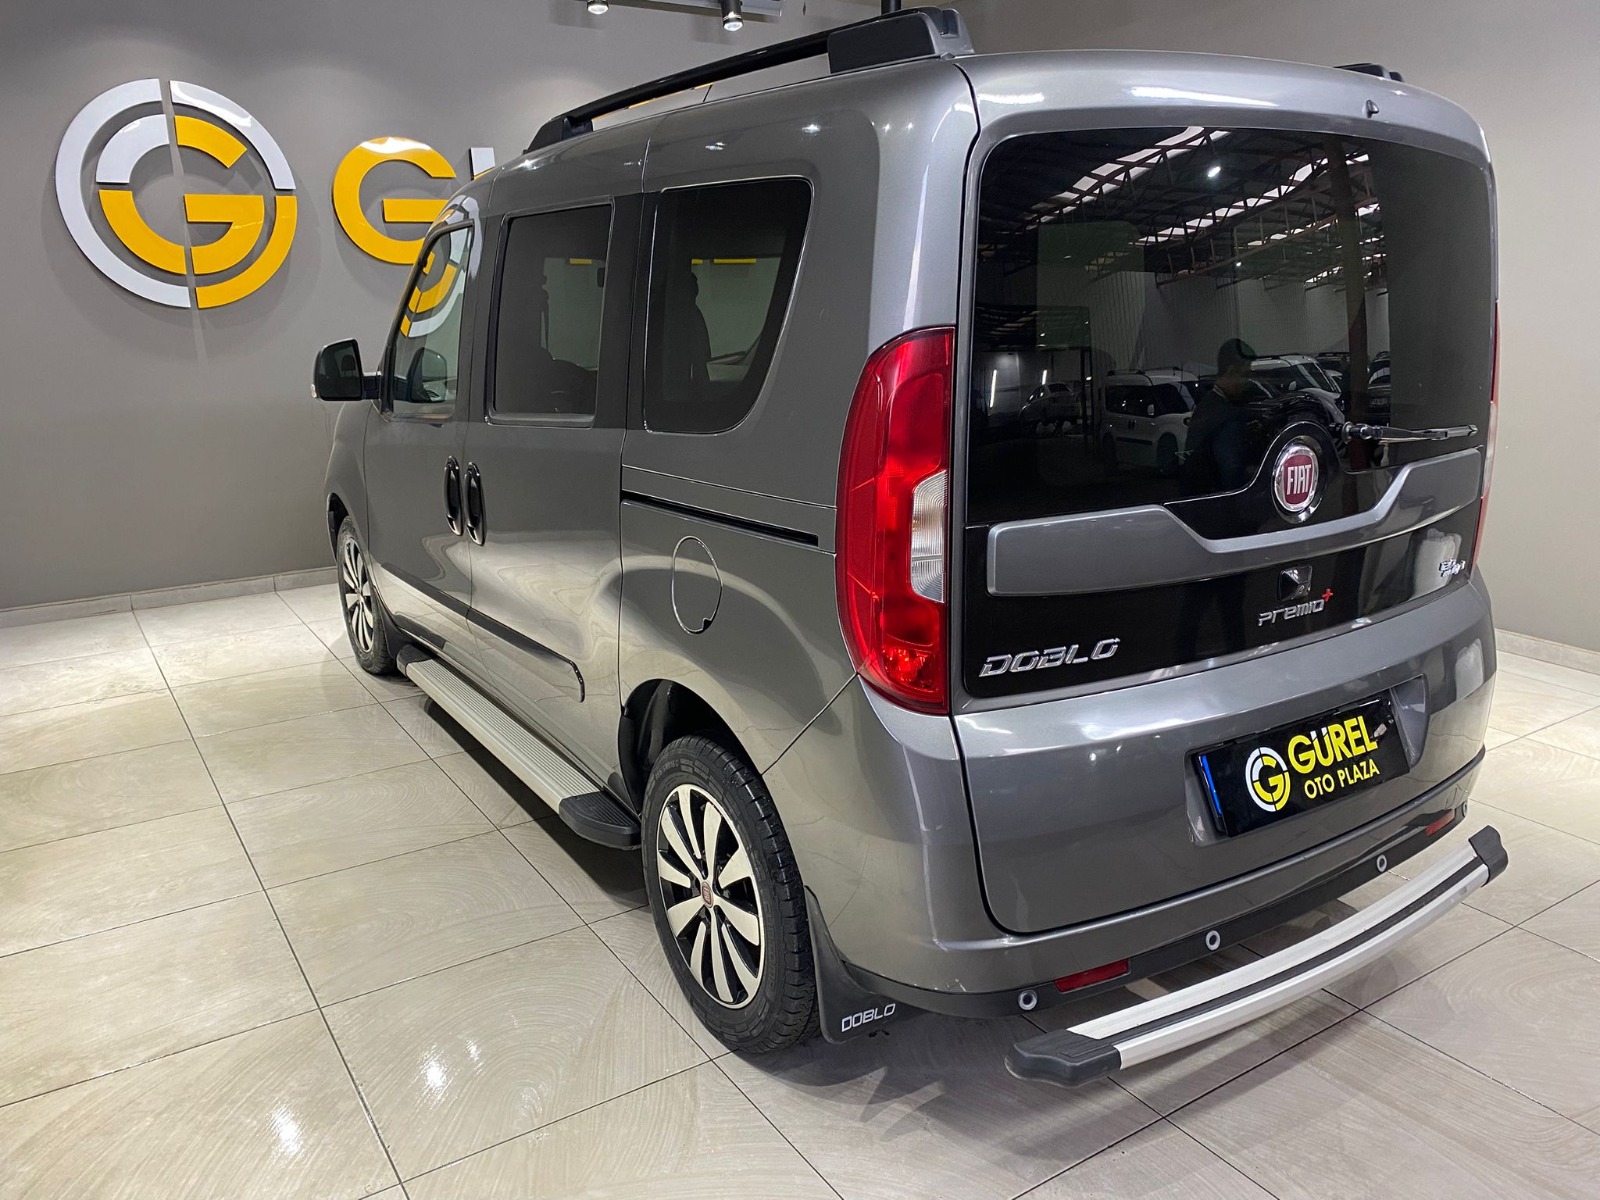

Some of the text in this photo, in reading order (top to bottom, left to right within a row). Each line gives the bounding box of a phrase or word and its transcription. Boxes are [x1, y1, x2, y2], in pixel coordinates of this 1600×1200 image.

[1286, 464, 1312, 496] FIAT
[978, 637, 1121, 678] DOBLO
[1304, 758, 1381, 799] OTO PLAZA
[841, 1003, 896, 1033] DOBLO
